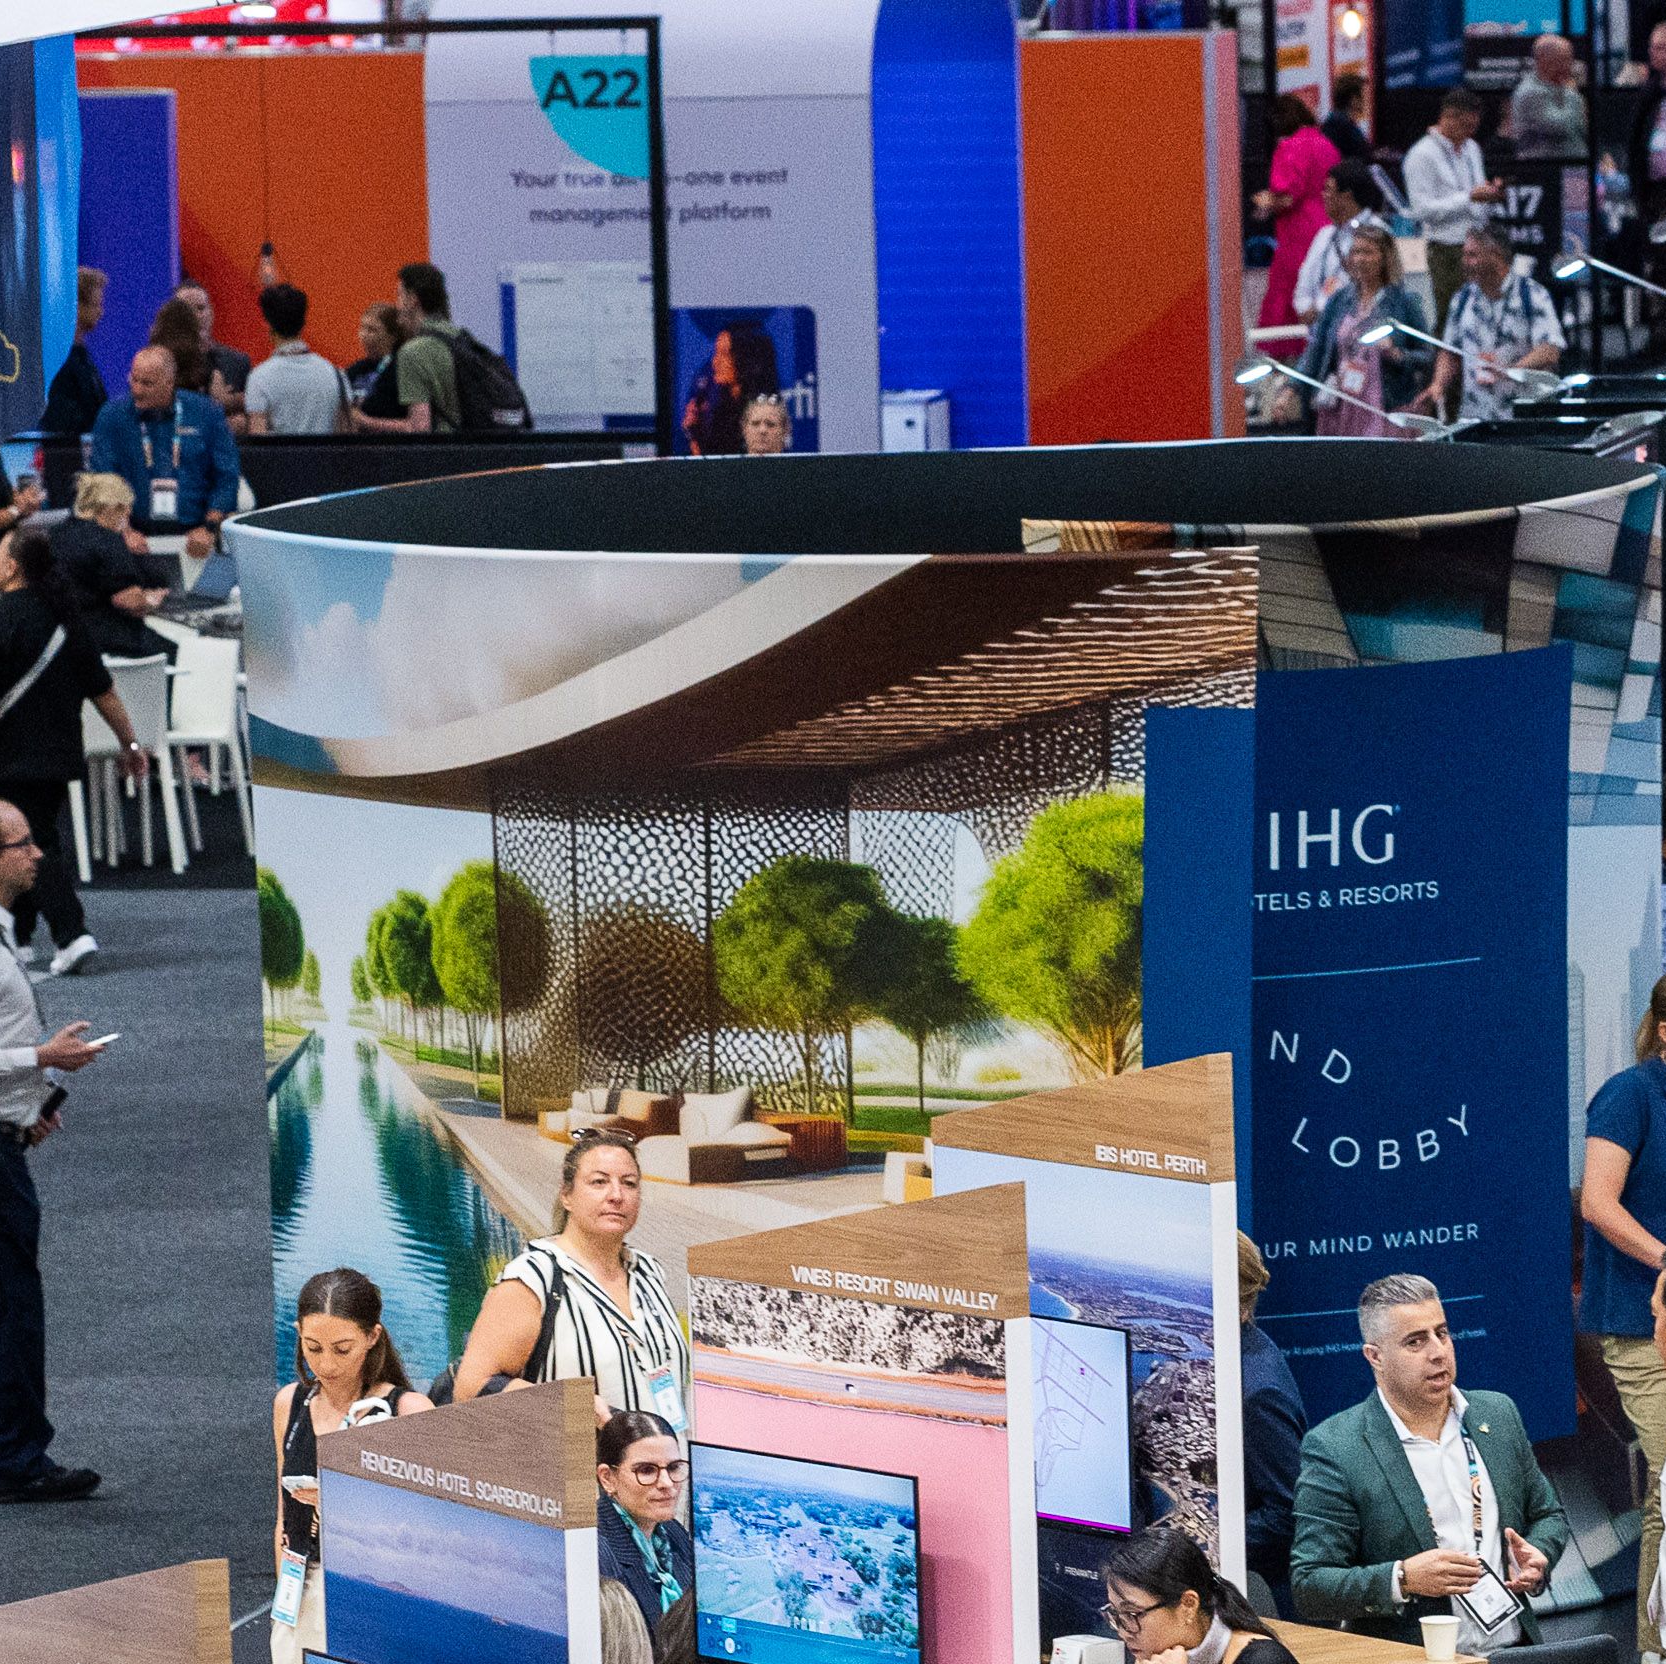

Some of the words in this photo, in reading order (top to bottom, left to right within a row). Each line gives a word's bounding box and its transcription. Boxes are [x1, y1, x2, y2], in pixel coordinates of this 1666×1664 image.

[542, 69, 641, 109] A22
[510, 168, 558, 187] Your
[564, 172, 605, 187] true
[730, 170, 788, 186] event
[530, 206, 671, 228] manageme
[679, 202, 772, 224] platform
[1270, 804, 1395, 870] IHG
[1251, 892, 1312, 911] TELS
[1318, 890, 1332, 908] &
[1339, 881, 1440, 906] RESORTS
[1292, 1104, 1468, 1170] LOBBY
[1120, 1147, 1162, 1170] HOTEL
[1164, 1154, 1208, 1176] PERTH
[1309, 1235, 1373, 1256] MIND
[1383, 1222, 1479, 1249] WANDER
[791, 1264, 832, 1288] VINES
[834, 1271, 892, 1296] RESORT
[894, 1279, 940, 1303] SWAN
[941, 1286, 998, 1311] VALLEY
[360, 1450, 434, 1487] RENDEZVOUS
[436, 1471, 474, 1498] HOTEL
[475, 1480, 563, 1519] SCARBOROUGH
